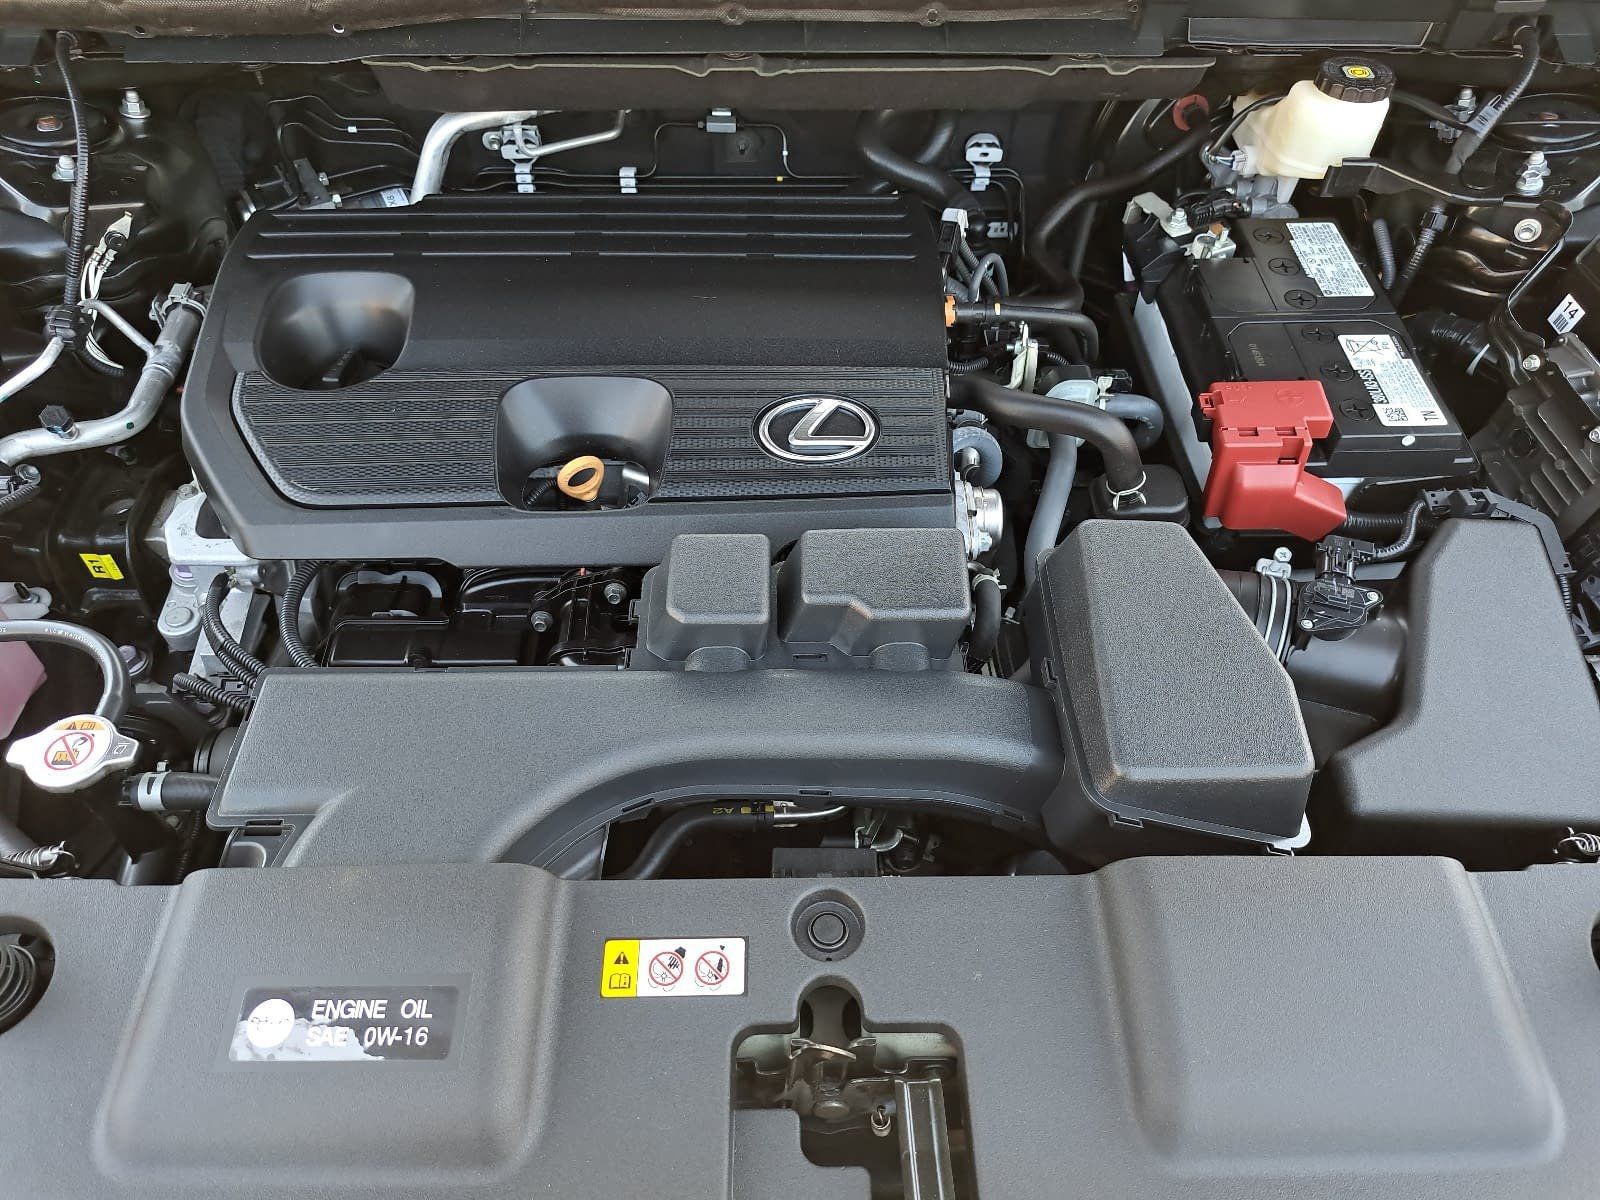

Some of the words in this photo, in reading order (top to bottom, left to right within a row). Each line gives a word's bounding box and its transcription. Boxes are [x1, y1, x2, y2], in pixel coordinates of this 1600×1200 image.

[1563, 301, 1579, 320] 14
[1420, 410, 1440, 421] TN
[87, 559, 107, 574] R1
[712, 807, 735, 815] A2
[312, 1000, 388, 1019] ENGINE
[400, 999, 433, 1019] OIL
[305, 1026, 350, 1047] SAE
[363, 1026, 429, 1047] 0W-16
